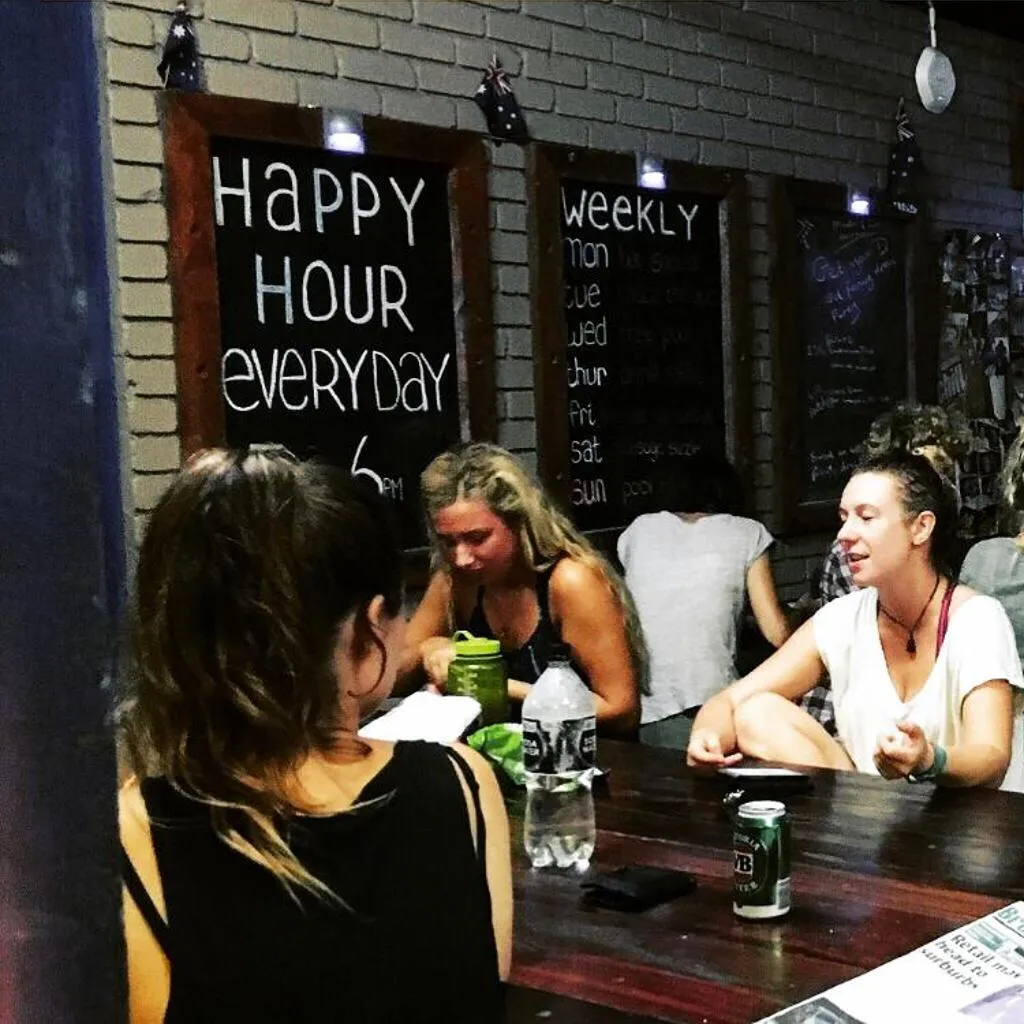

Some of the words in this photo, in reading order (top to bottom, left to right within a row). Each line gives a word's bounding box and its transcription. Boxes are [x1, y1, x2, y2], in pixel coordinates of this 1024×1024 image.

[562, 236, 610, 270] mon
[255, 252, 415, 333] HOUR
[568, 399, 597, 427] fri
[570, 436, 604, 464] sat
[570, 477, 608, 507] sun
[936, 940, 973, 967] head
[970, 965, 989, 978] to
[950, 934, 995, 964] Retail
